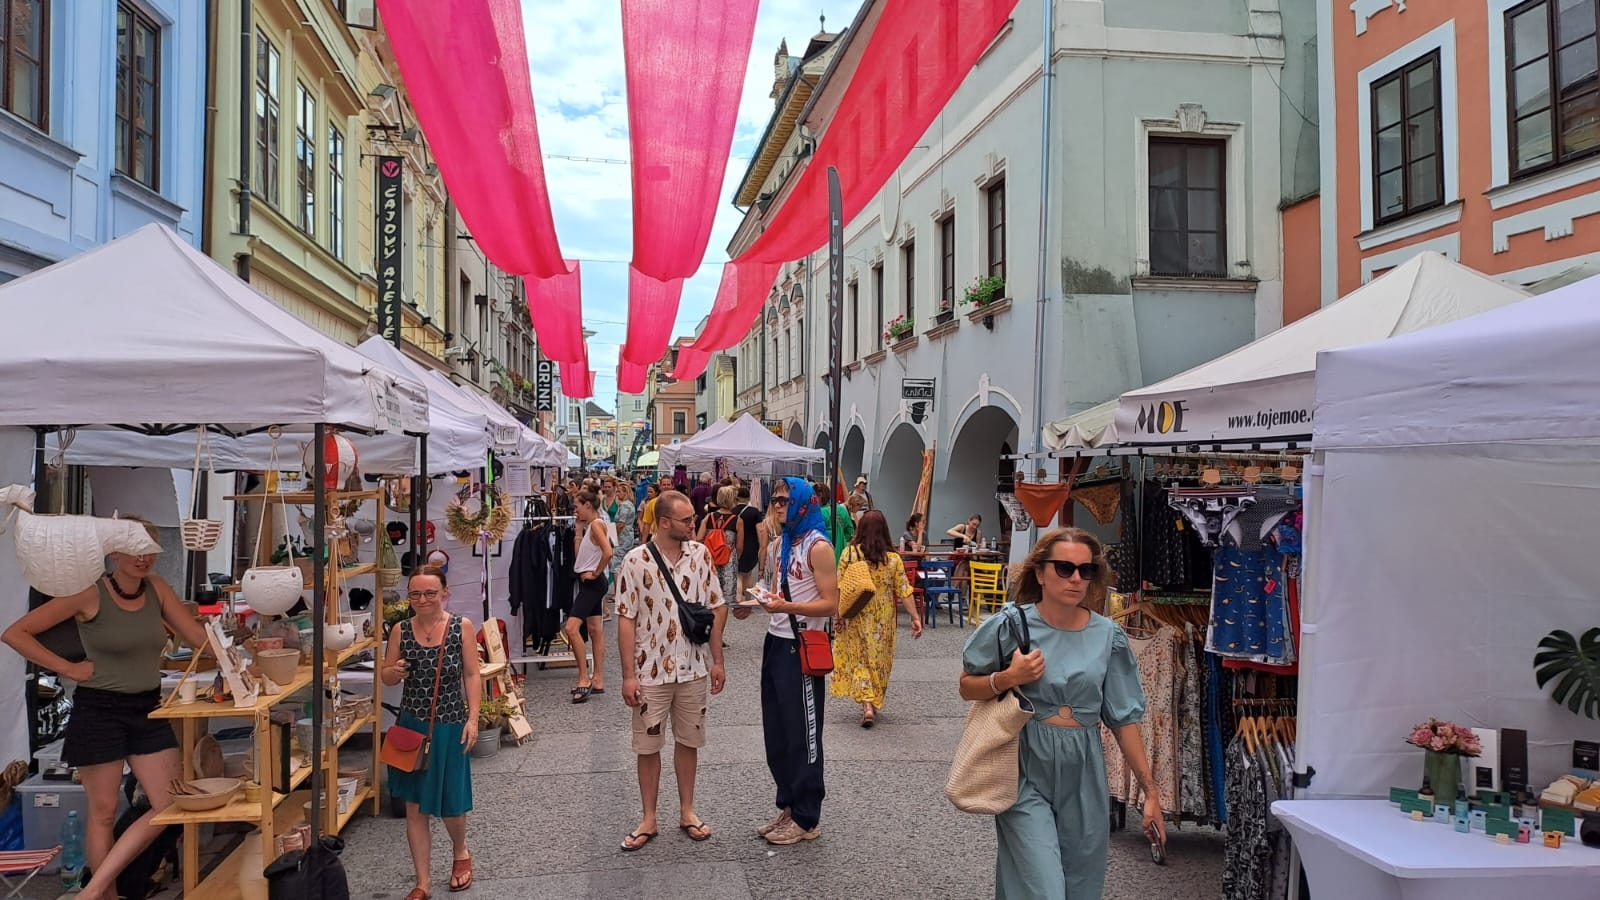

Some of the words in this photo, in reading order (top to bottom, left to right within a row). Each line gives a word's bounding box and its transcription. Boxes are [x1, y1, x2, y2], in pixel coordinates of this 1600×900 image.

[383, 184, 398, 260] ČAJOVÝ
[830, 212, 839, 369] MARKET
[1134, 399, 1190, 434] MOE
[1227, 408, 1314, 430] www.tojemoe.
